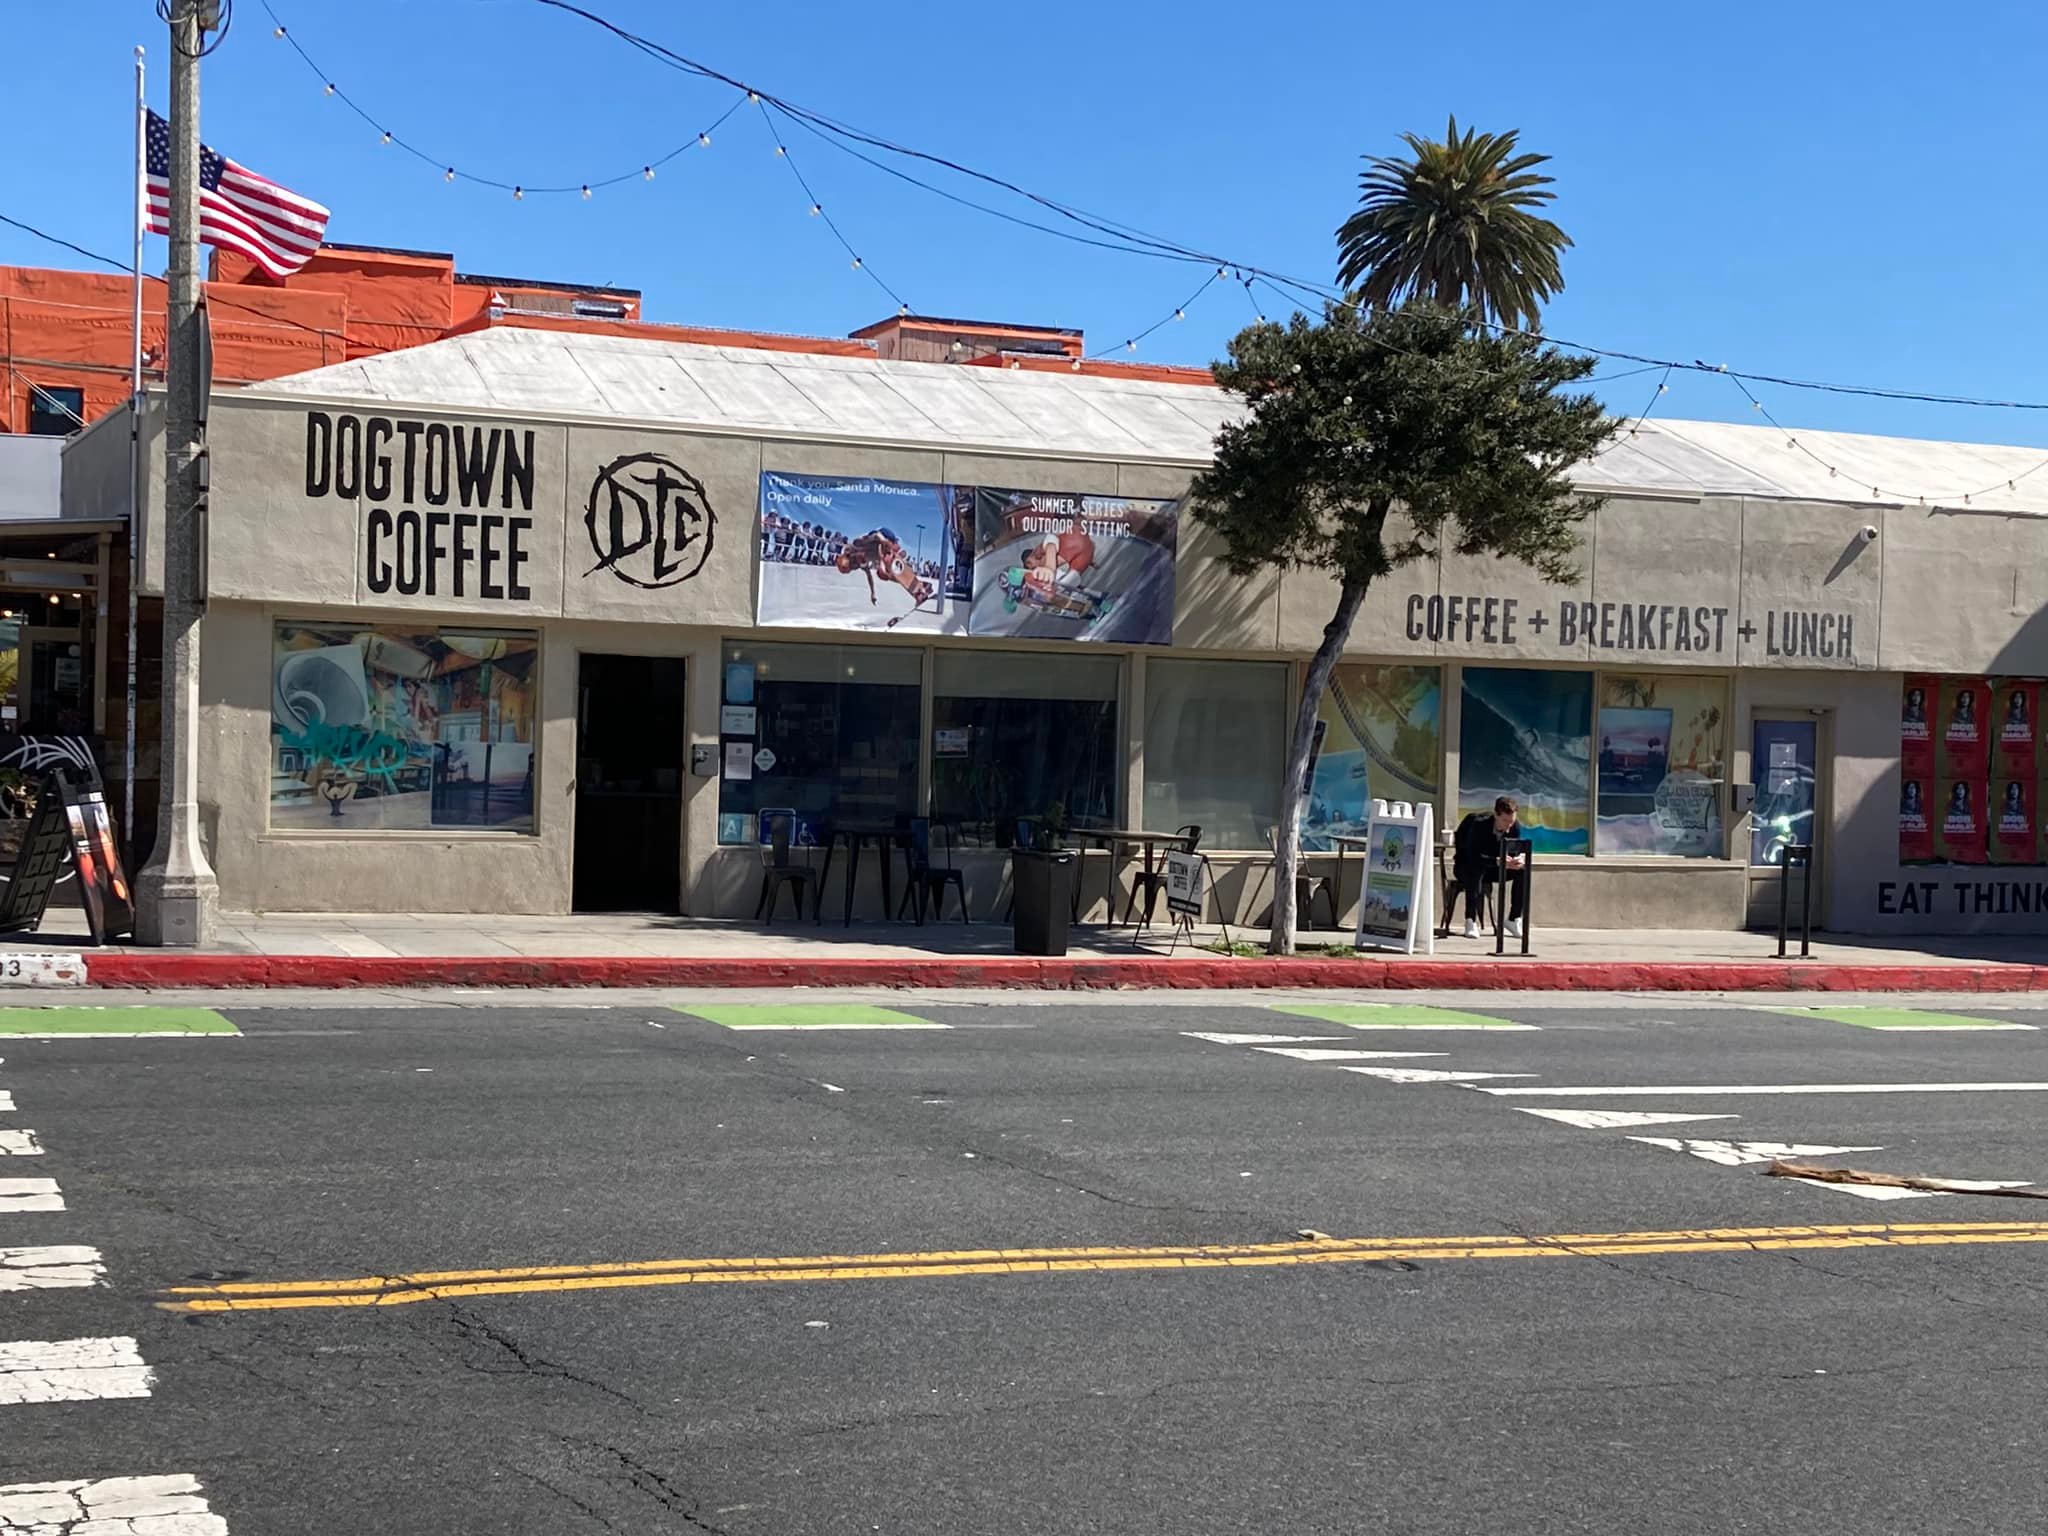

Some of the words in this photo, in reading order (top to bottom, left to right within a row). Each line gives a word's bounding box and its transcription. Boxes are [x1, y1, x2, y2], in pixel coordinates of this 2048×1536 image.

[306, 411, 535, 510] DOGTOWN
[767, 491, 801, 504] Open
[803, 493, 832, 507] daily
[836, 481, 870, 493] Santa
[874, 484, 920, 496] Monica.
[1031, 497, 1074, 514] SUMMER
[1081, 500, 1125, 518] SERIES
[1022, 516, 1073, 535] OUTDOOR
[1081, 520, 1130, 538] SITTING
[367, 508, 532, 600] COFFEE
[1405, 594, 1518, 645] COFFEE
[1559, 600, 1728, 653] BREAKFAST
[1765, 611, 1853, 658] LUNCH
[1878, 882, 1939, 915] EAT
[0, 959, 20, 977] 3
